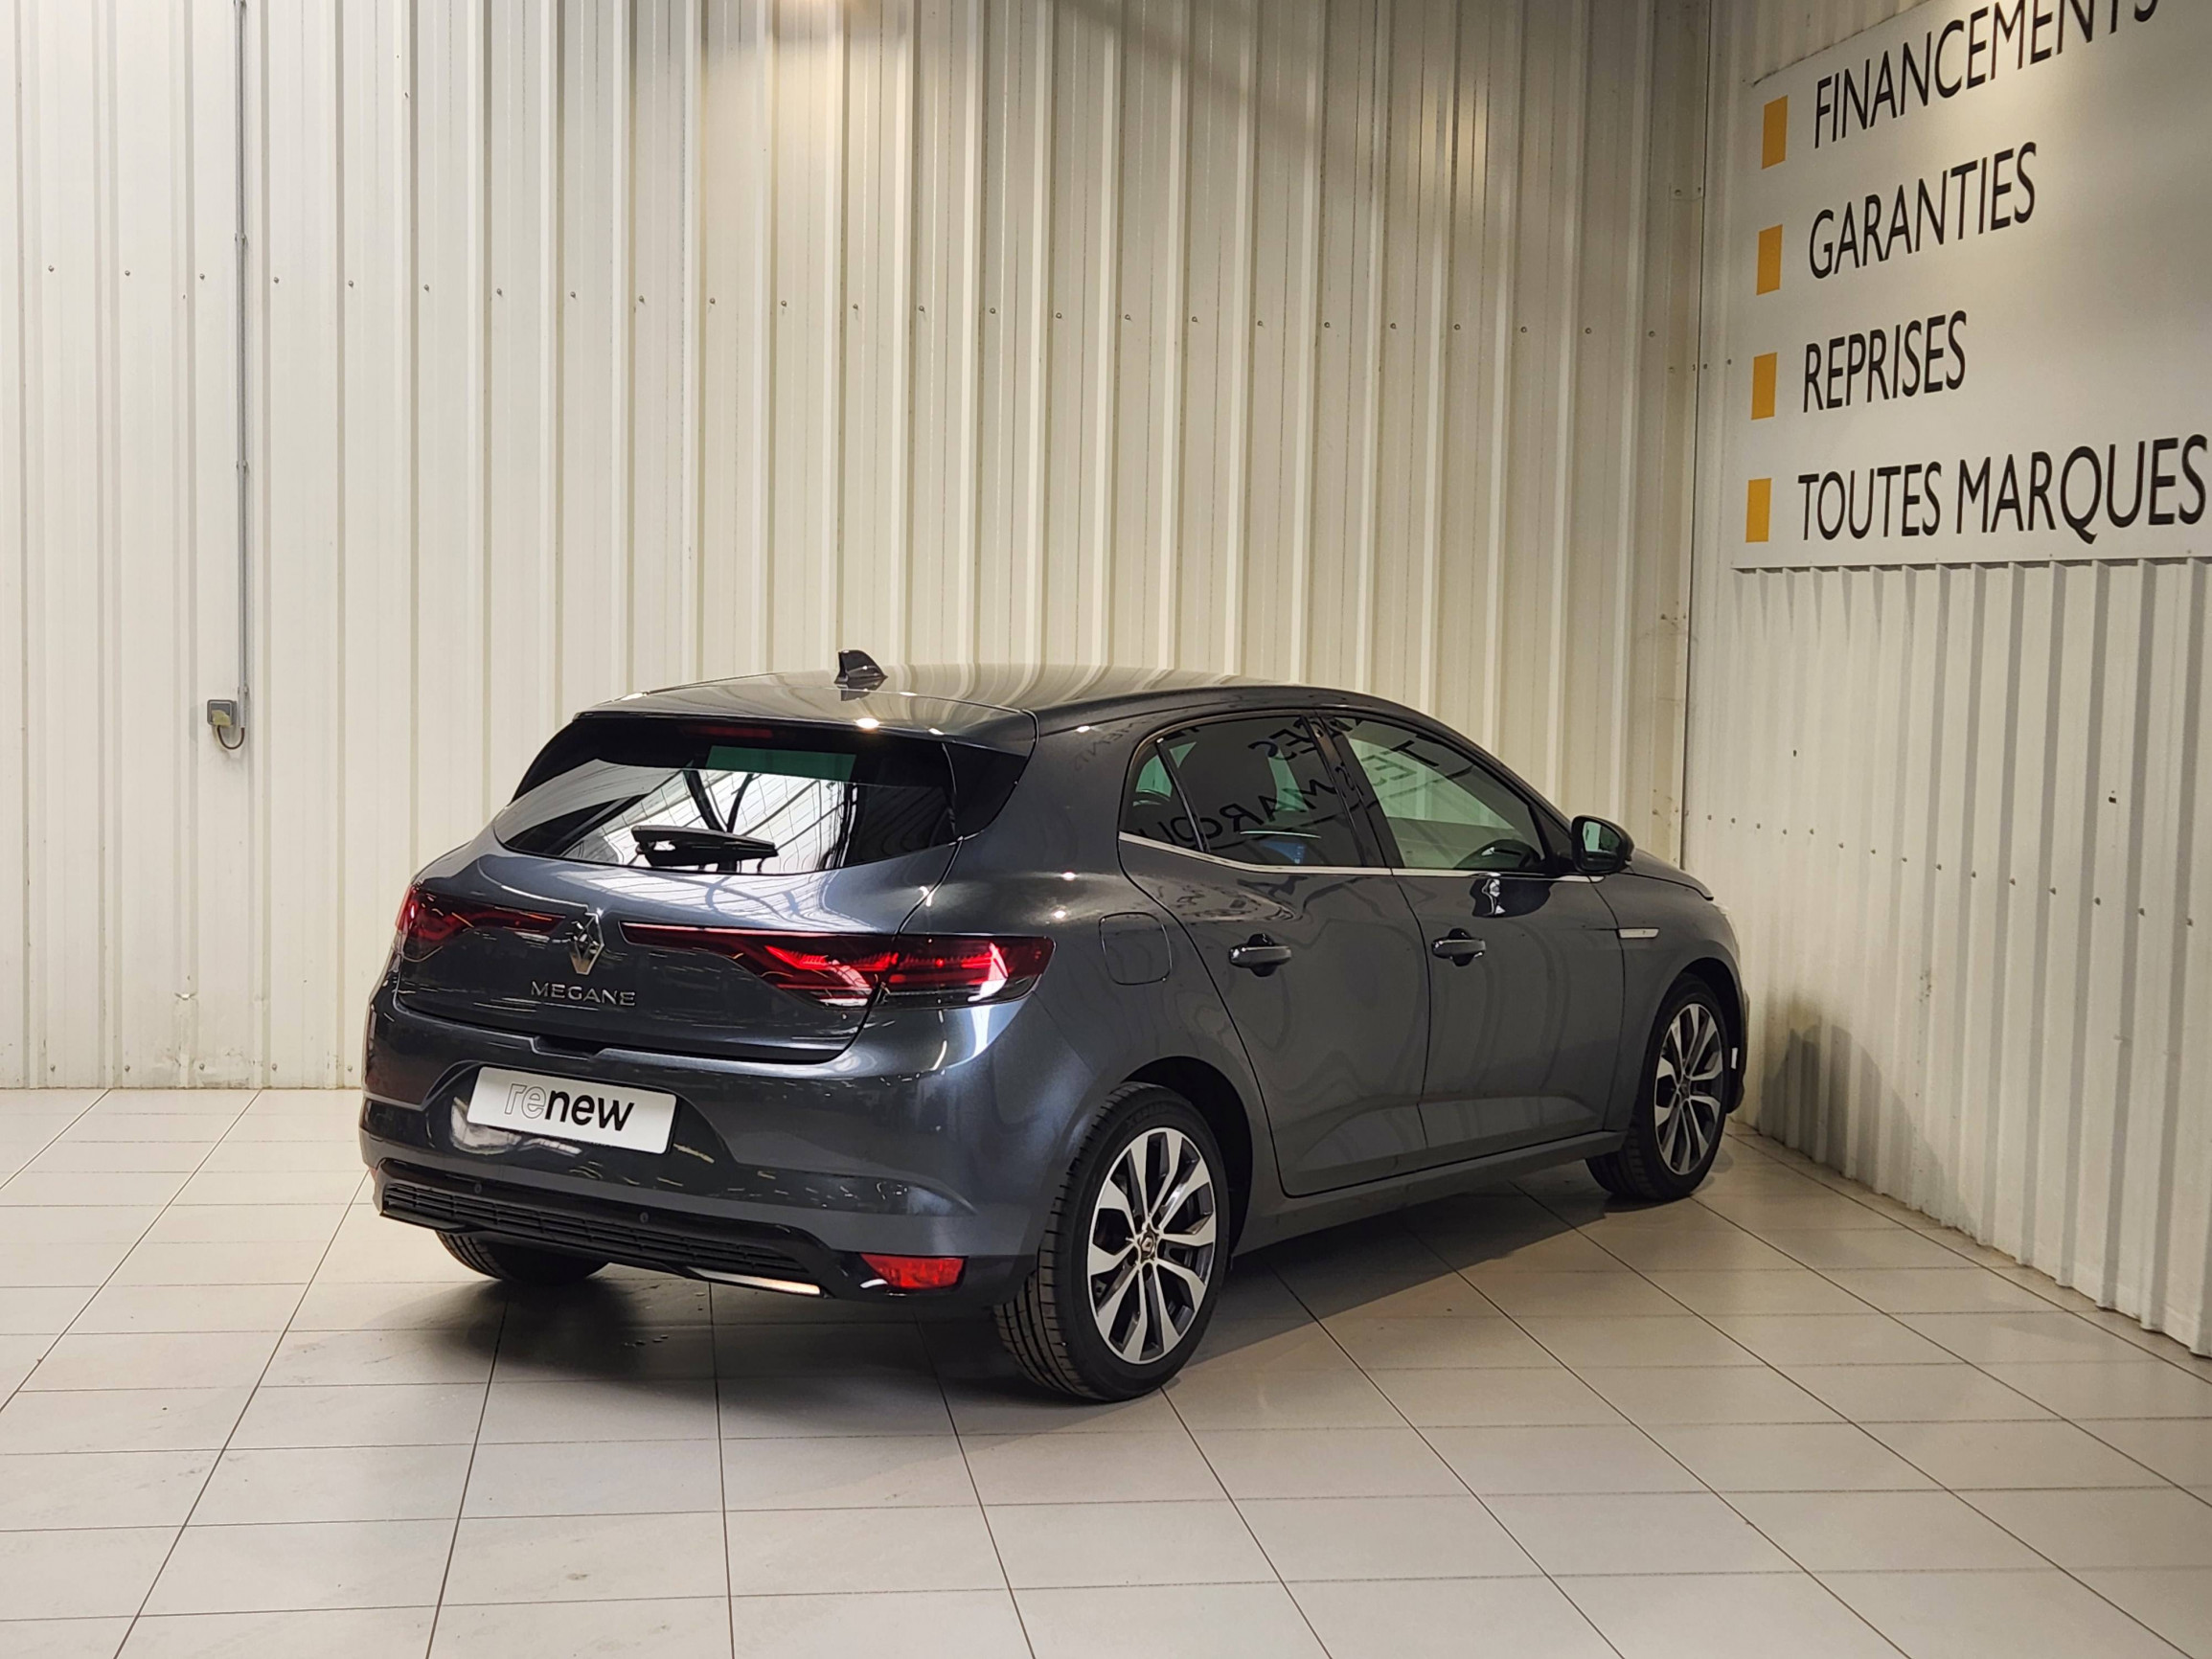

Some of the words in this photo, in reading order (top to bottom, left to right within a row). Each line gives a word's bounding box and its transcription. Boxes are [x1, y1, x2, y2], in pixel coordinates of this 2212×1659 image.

[1814, 0, 2157, 148] FINANCEMEN
[1809, 142, 2037, 279] GARANTIES
[1803, 310, 1967, 413] REPRISES
[1798, 461, 1942, 540] TOUTES
[1956, 434, 2208, 544] MARQUES
[531, 981, 635, 1006] MEGANE
[505, 1084, 634, 1130] renew
